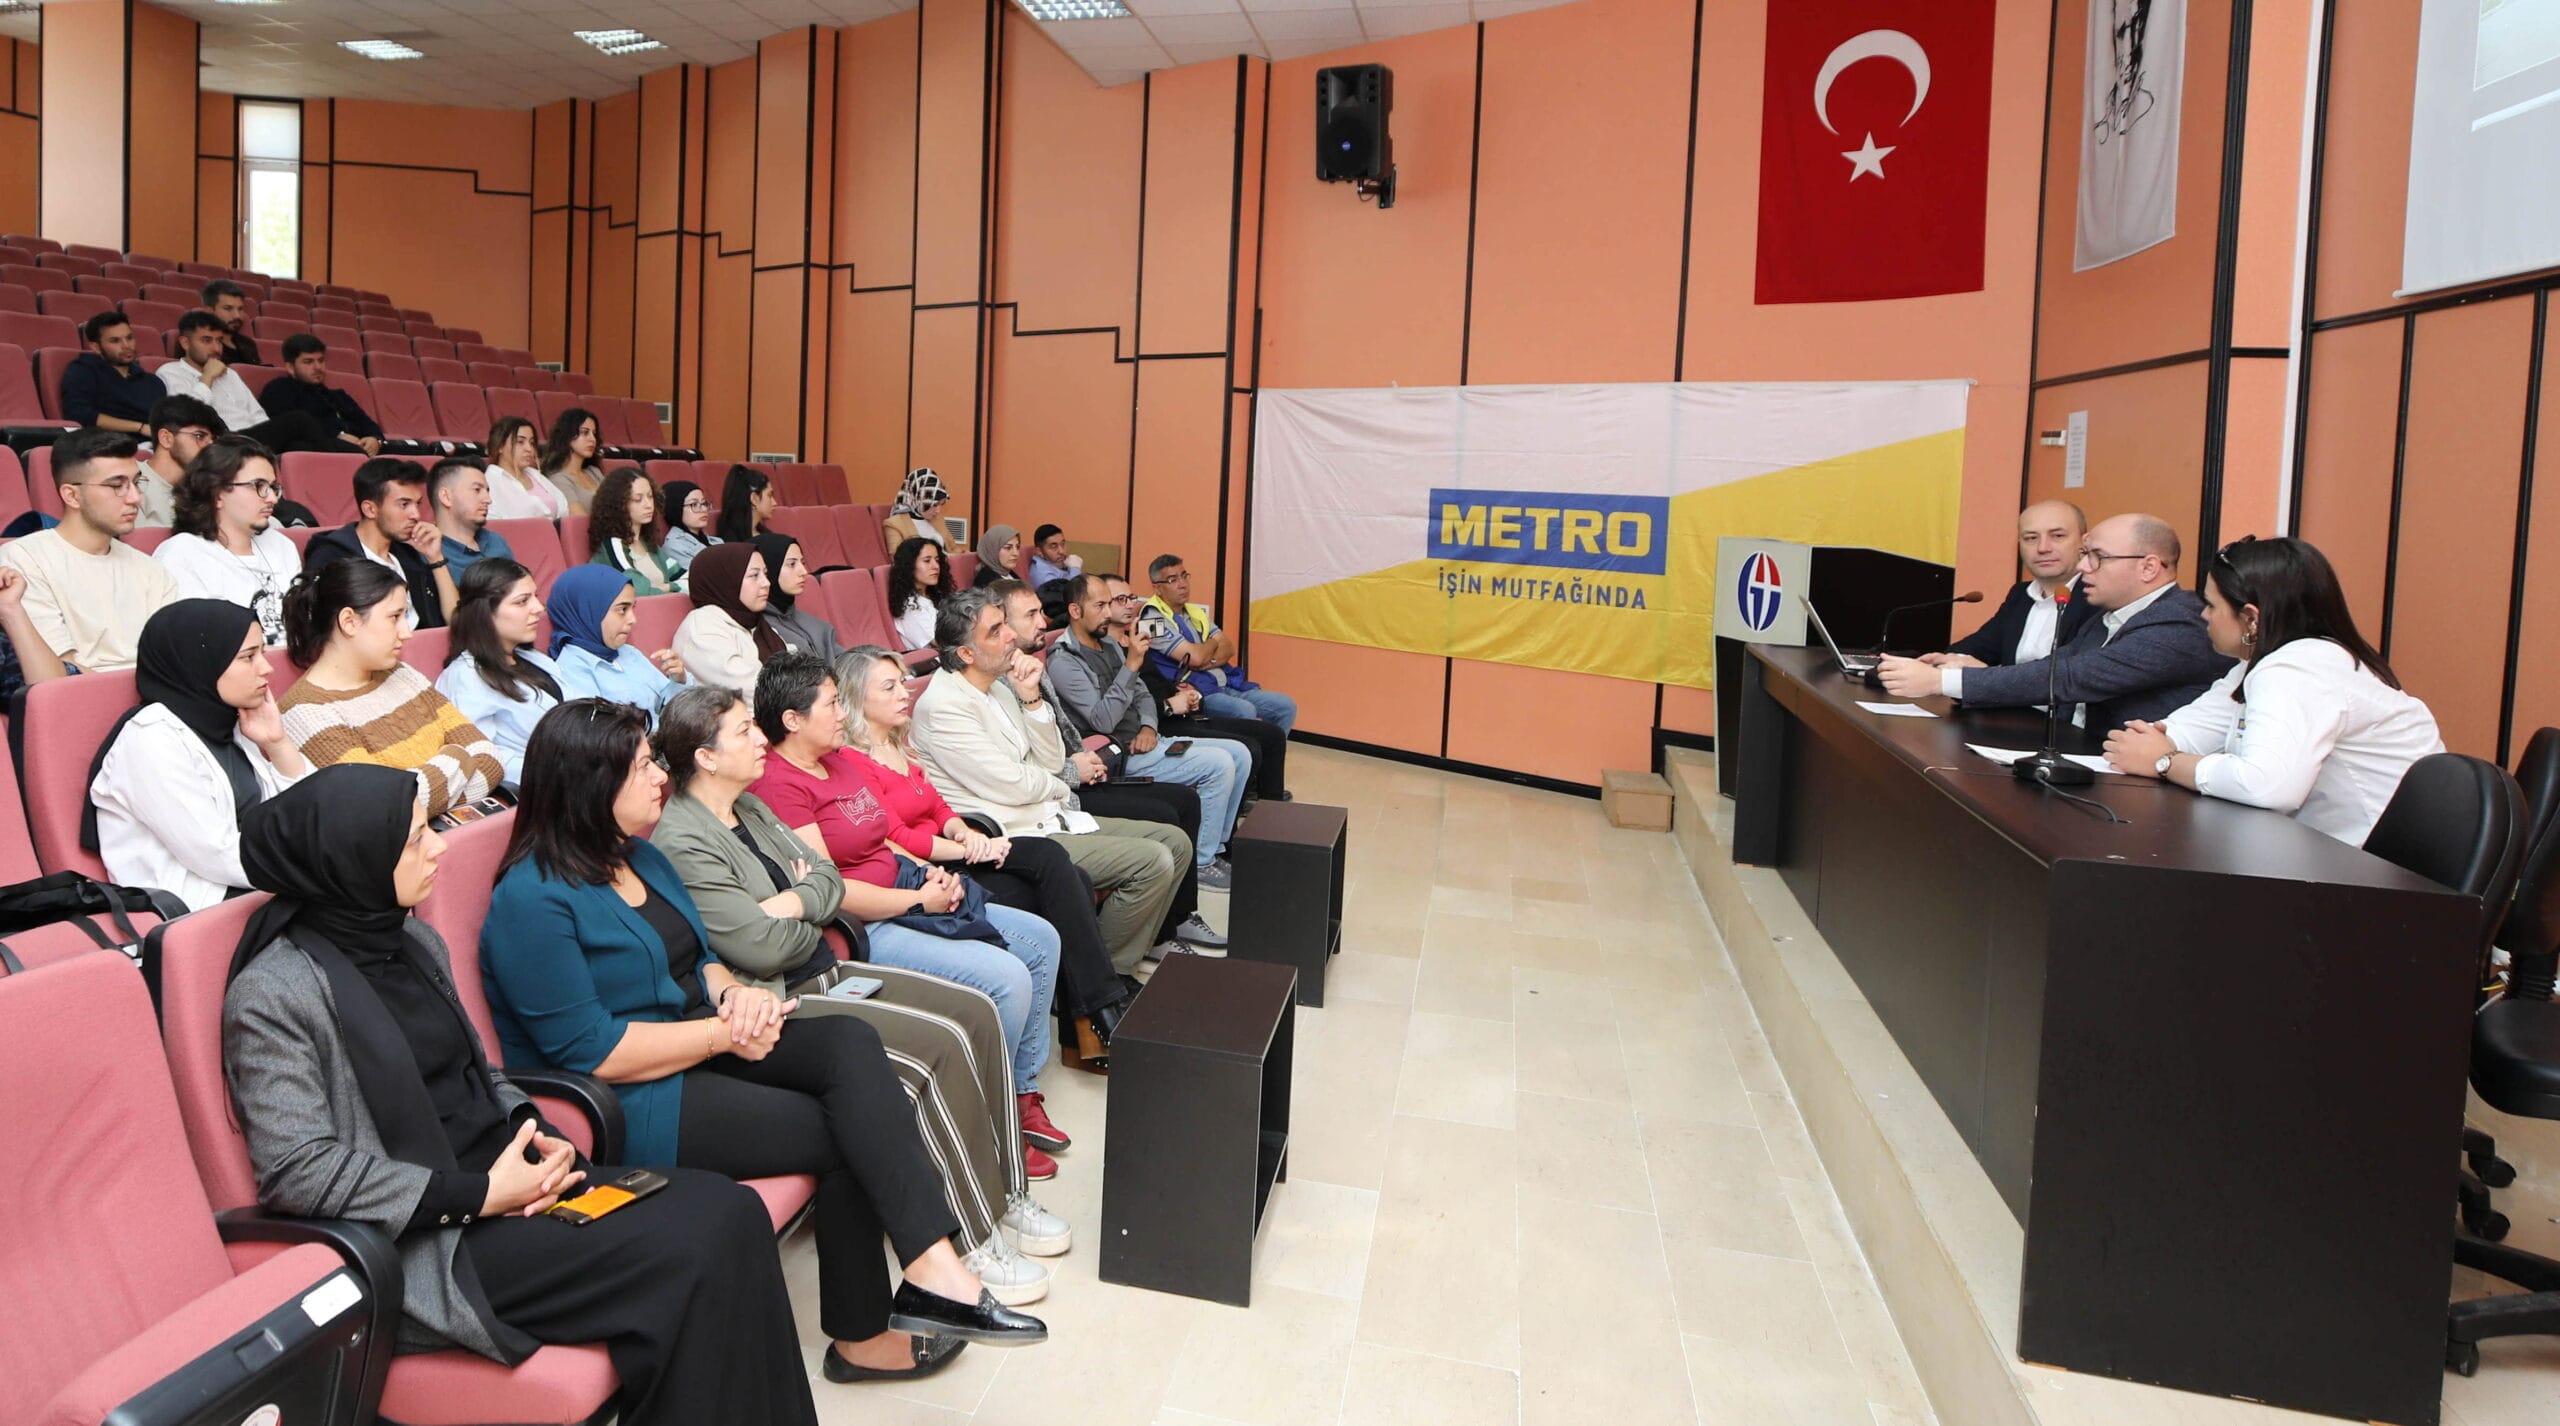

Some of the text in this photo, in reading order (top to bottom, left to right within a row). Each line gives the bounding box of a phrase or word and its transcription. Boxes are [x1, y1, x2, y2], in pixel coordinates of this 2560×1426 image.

[1441, 504, 1652, 557] METRO
[1439, 566, 1647, 610] İŞİN MUTFAĞINDA
